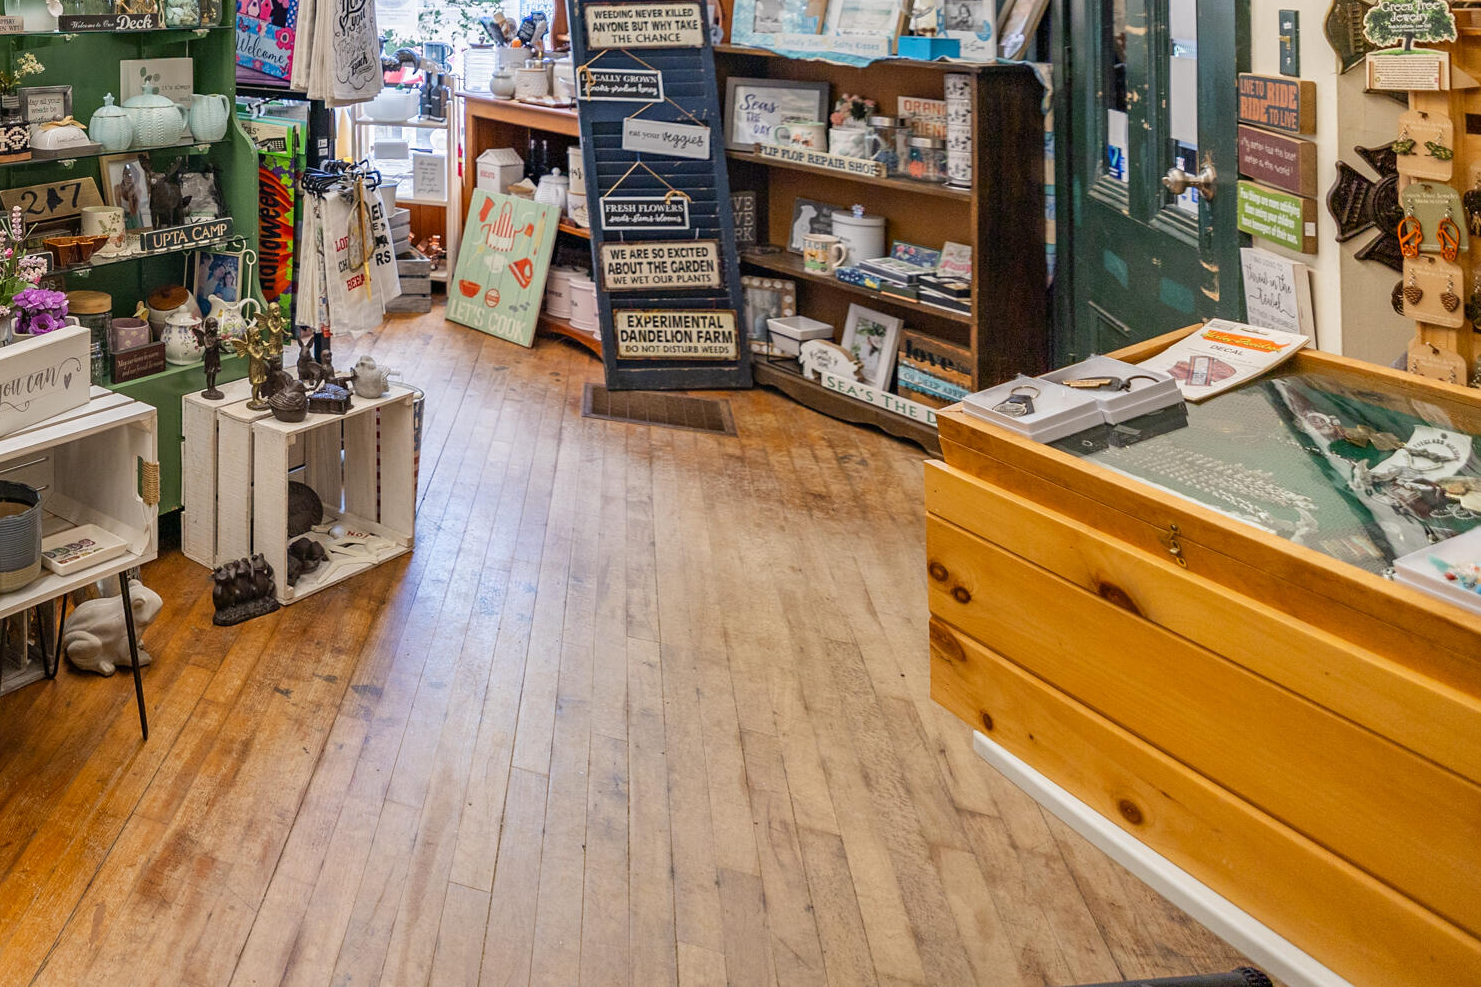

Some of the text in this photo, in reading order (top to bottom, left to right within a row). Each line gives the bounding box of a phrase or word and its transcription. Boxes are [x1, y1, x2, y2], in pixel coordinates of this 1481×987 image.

[1381, 0, 1440, 12] Green Tree
[594, 8, 694, 19] WEEDING NEVER KILLED
[1390, 11, 1429, 24] Jewelry
[117, 15, 153, 30] Deck
[593, 20, 698, 32] ANYONE BUT WHY TAKE
[612, 33, 681, 43] THE CHANCE
[236, 33, 285, 63] Welcome
[623, 75, 658, 83] GROWN
[1240, 79, 1297, 109] LIVE TO RIDE
[739, 94, 779, 112] Seas
[1240, 96, 1297, 129] RIDE TO LIVE
[629, 130, 639, 138] eat
[642, 132, 660, 140] your
[759, 145, 779, 156] FLIP
[781, 148, 805, 161] FLOP
[808, 154, 846, 169] REPAIR
[1240, 188, 1249, 199] Few
[1249, 193, 1261, 205] things
[1269, 199, 1280, 207] more
[605, 203, 684, 213] FRESH FLOWERS
[153, 223, 229, 249] UPTA CAMP
[610, 247, 708, 260] WE ARE SO EXCITED
[608, 260, 714, 275] ABOUT THE GARDEN
[613, 274, 711, 284] WE WET OUR PLANTS
[450, 299, 527, 343] LET'S COOK
[627, 315, 724, 328] EXPERIMENTAL
[620, 329, 733, 344] DANDELION FARM
[625, 345, 730, 354] DO NOT DISTURB WEEDS
[1210, 345, 1244, 356] DECAL
[827, 376, 918, 418] SEA'S THE
